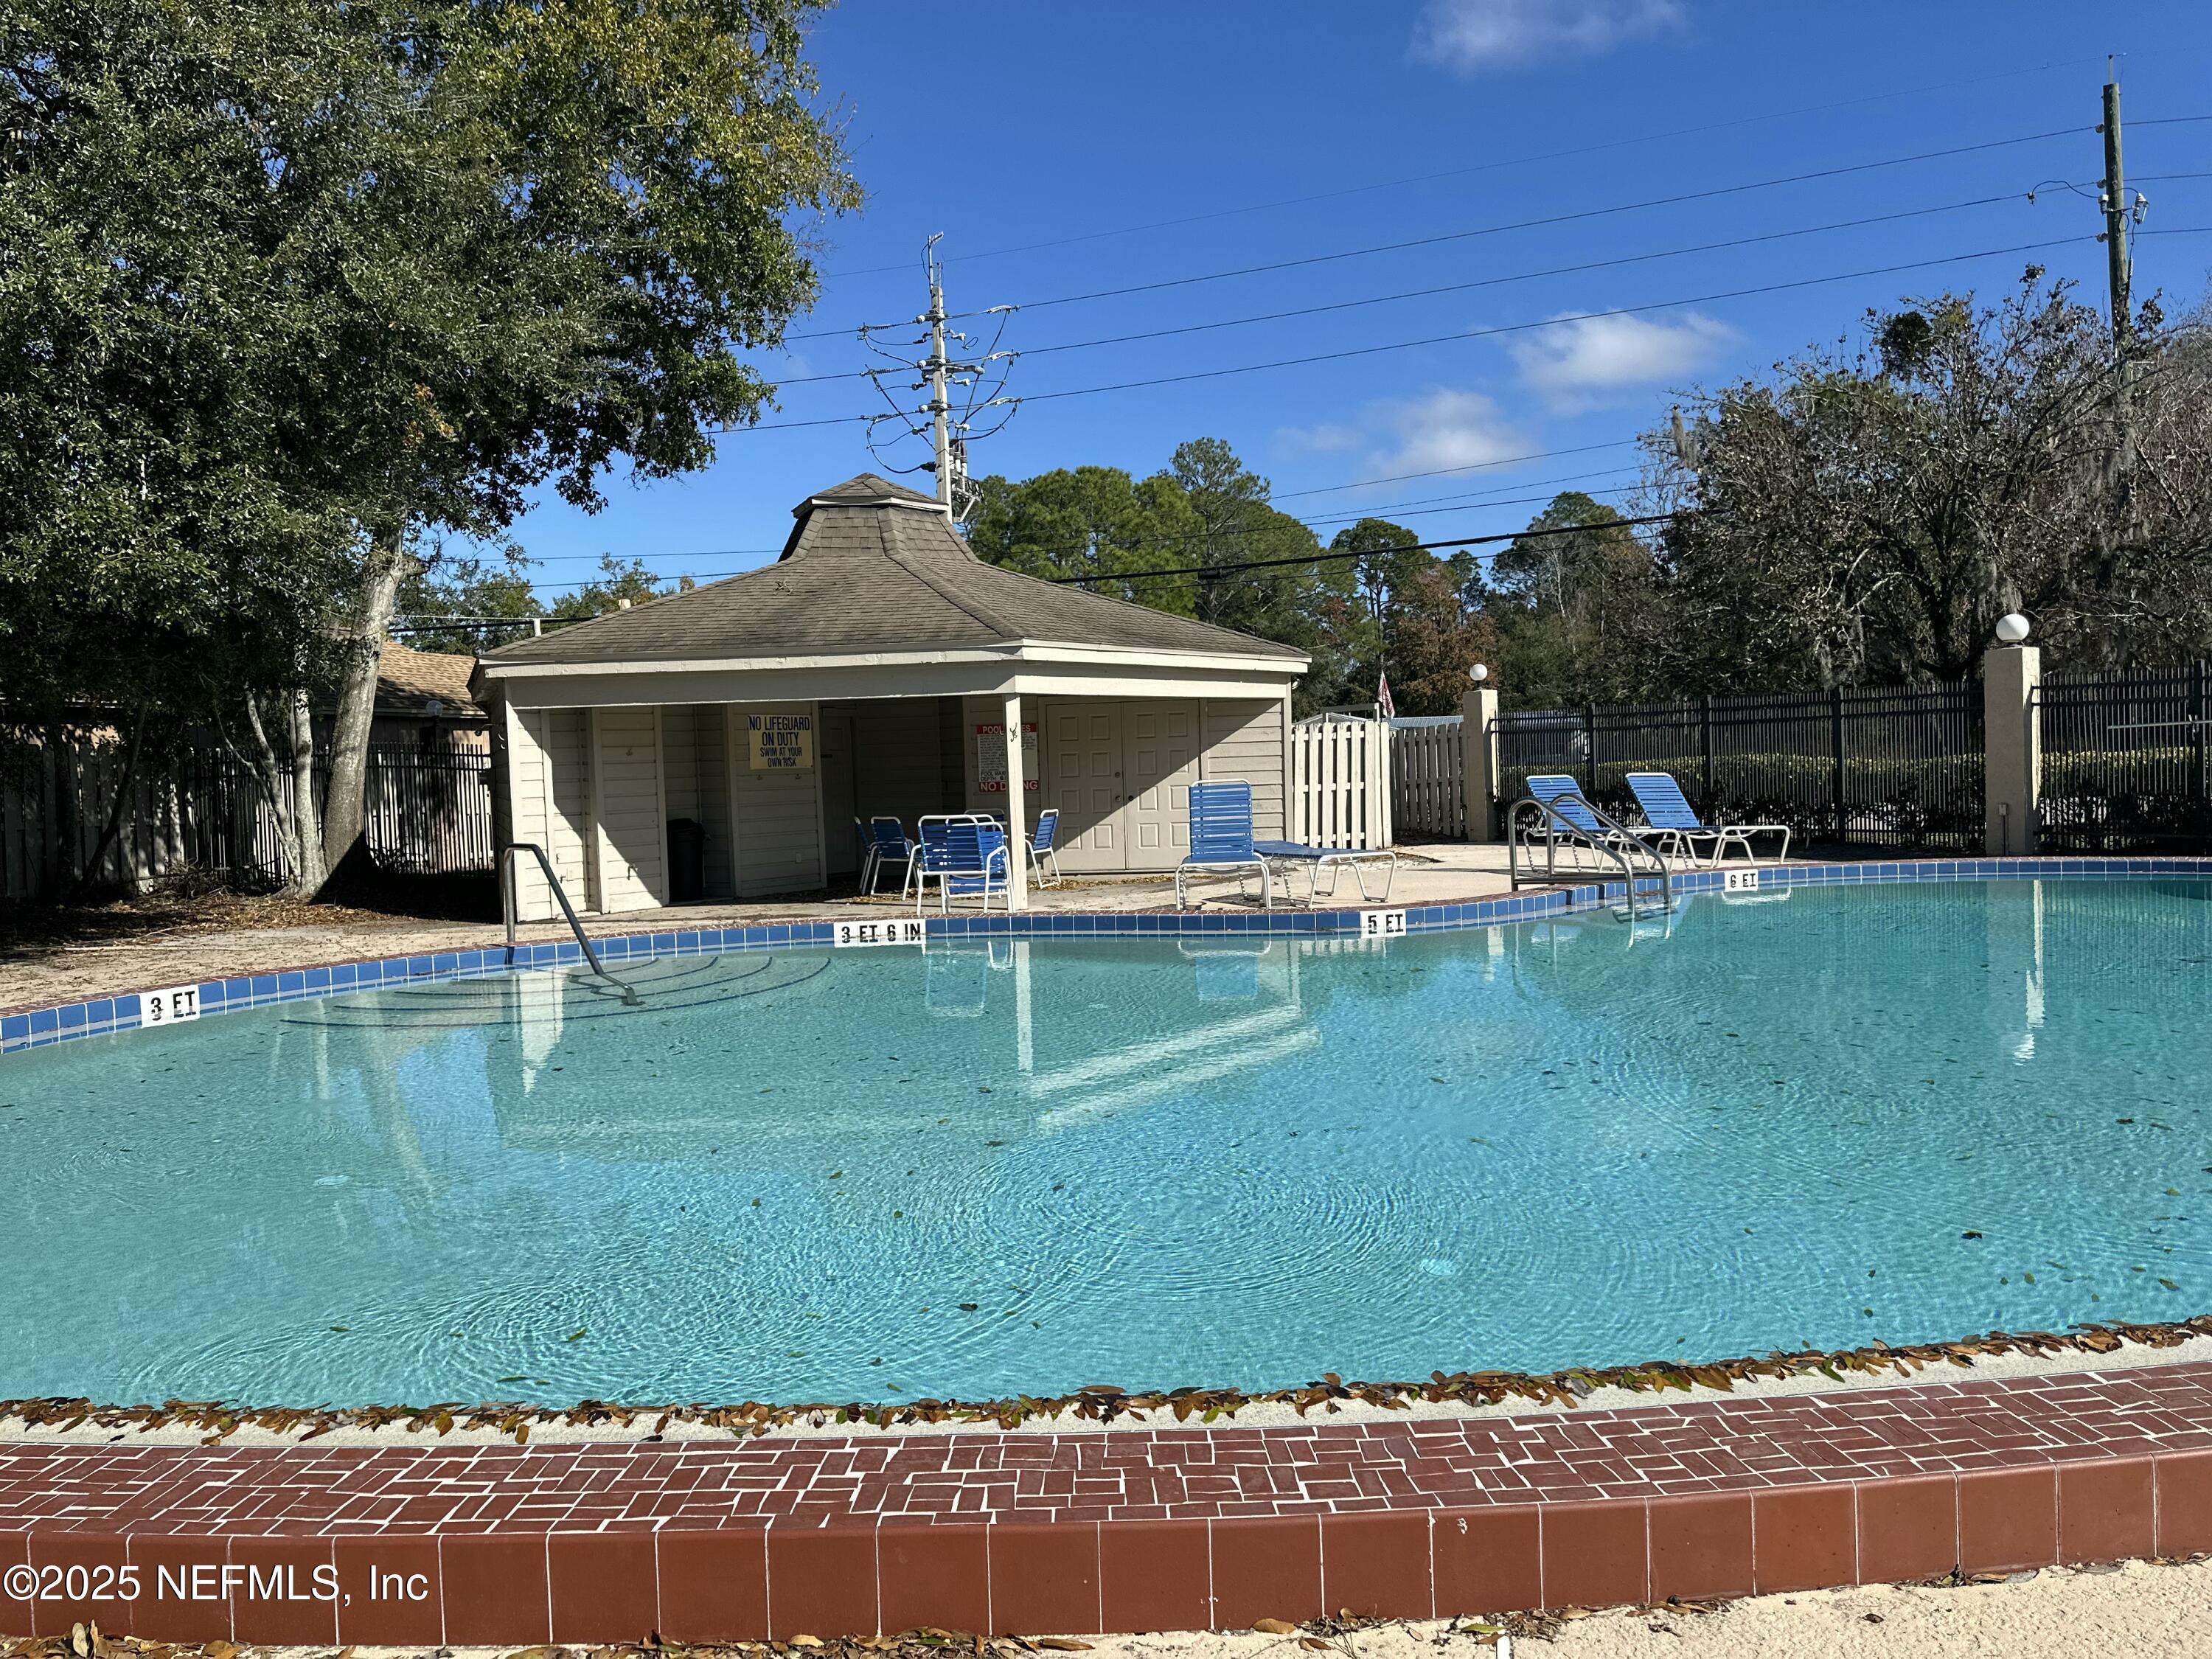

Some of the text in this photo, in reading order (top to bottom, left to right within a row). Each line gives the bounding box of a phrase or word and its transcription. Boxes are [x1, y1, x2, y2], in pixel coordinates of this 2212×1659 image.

[749, 716, 810, 731] NO LIFEGUARD
[983, 726, 1004, 734] POOL
[762, 732, 799, 746] ON DUTY
[760, 747, 802, 757] SWIM AT YOUR
[768, 757, 796, 767] OWN RISK
[980, 782, 997, 791] NO
[1731, 874, 1736, 888] 6
[1368, 915, 1377, 934] 5
[841, 926, 850, 943] 3
[887, 925, 896, 942] 6
[904, 923, 921, 941] IN
[150, 997, 162, 1020] 3
